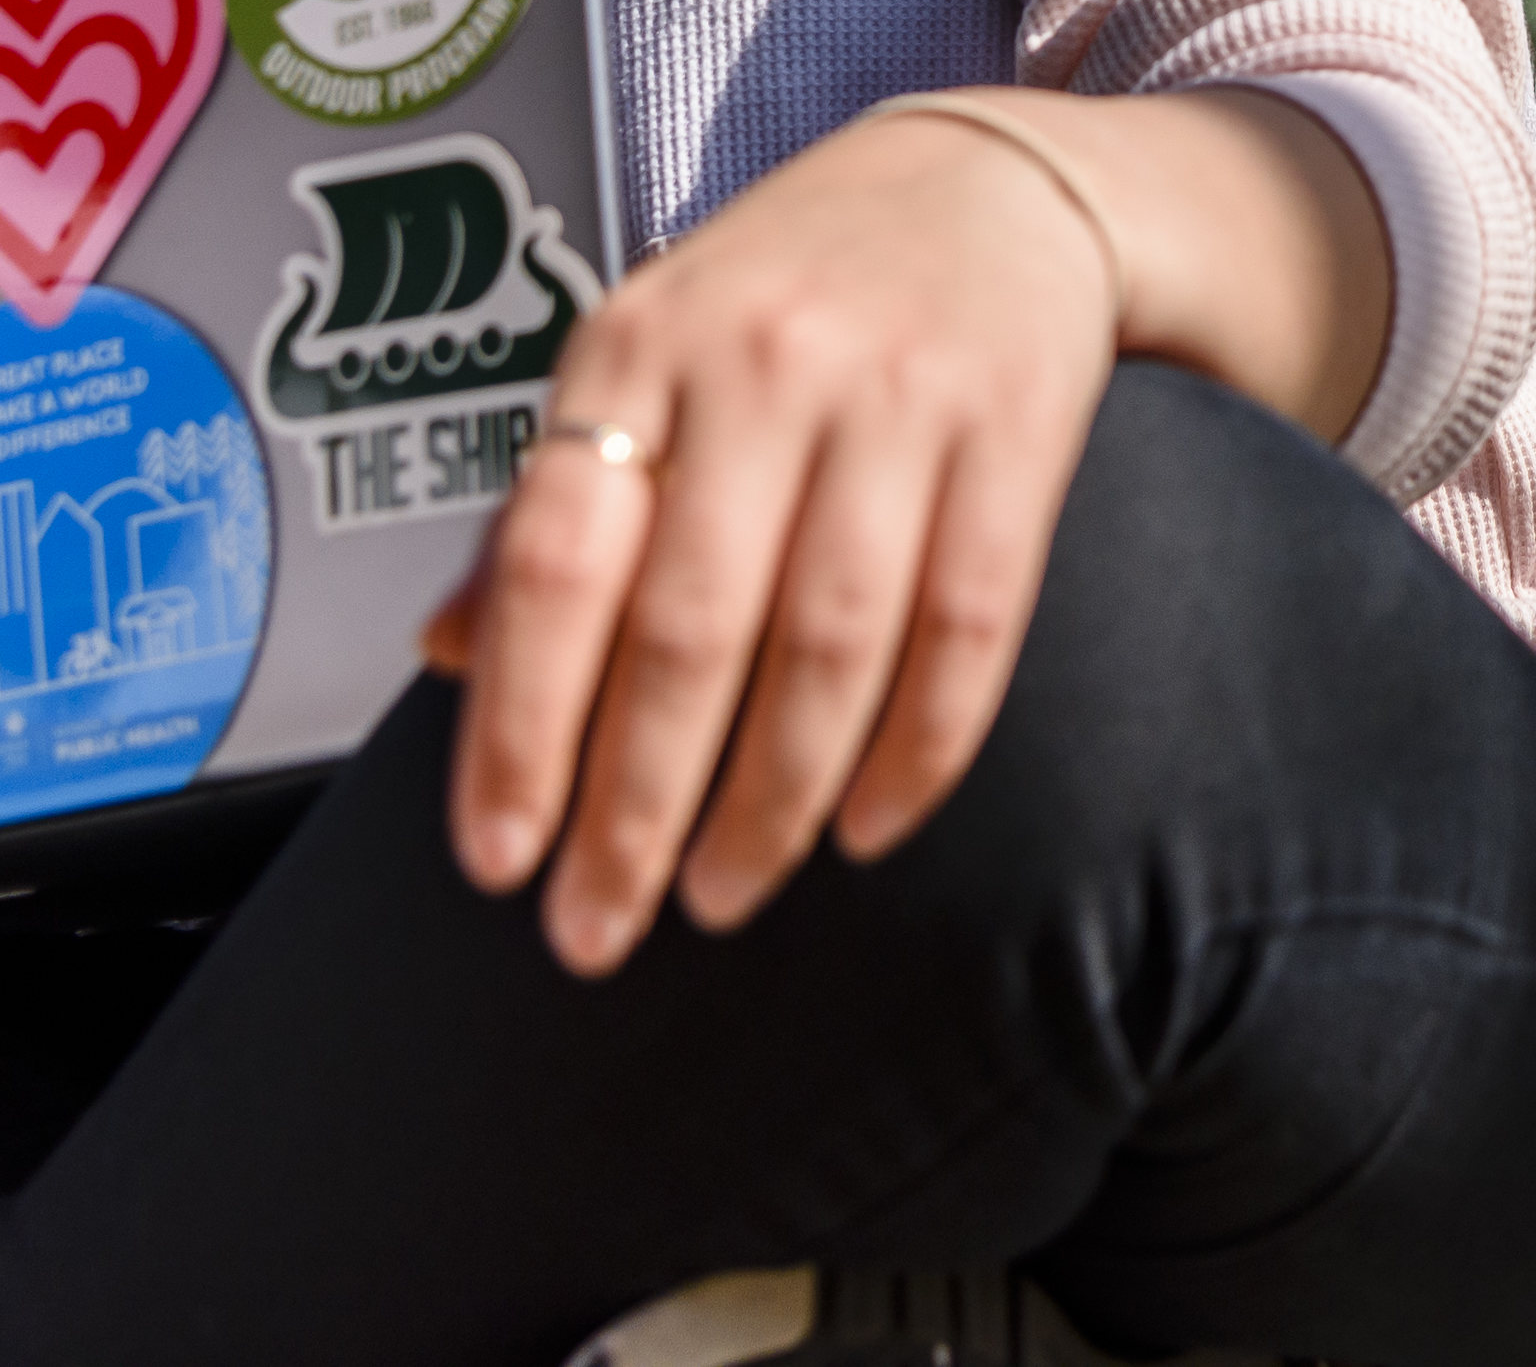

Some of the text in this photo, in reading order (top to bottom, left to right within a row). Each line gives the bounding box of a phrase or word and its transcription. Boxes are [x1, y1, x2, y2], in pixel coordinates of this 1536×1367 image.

[261, 41, 383, 116] OUTDOOR
[50, 336, 126, 378] PLACE
[38, 389, 58, 415] A
[59, 365, 150, 410] WORLD
[318, 405, 537, 521] THE SHIP
[124, 715, 201, 747] HEALTH
